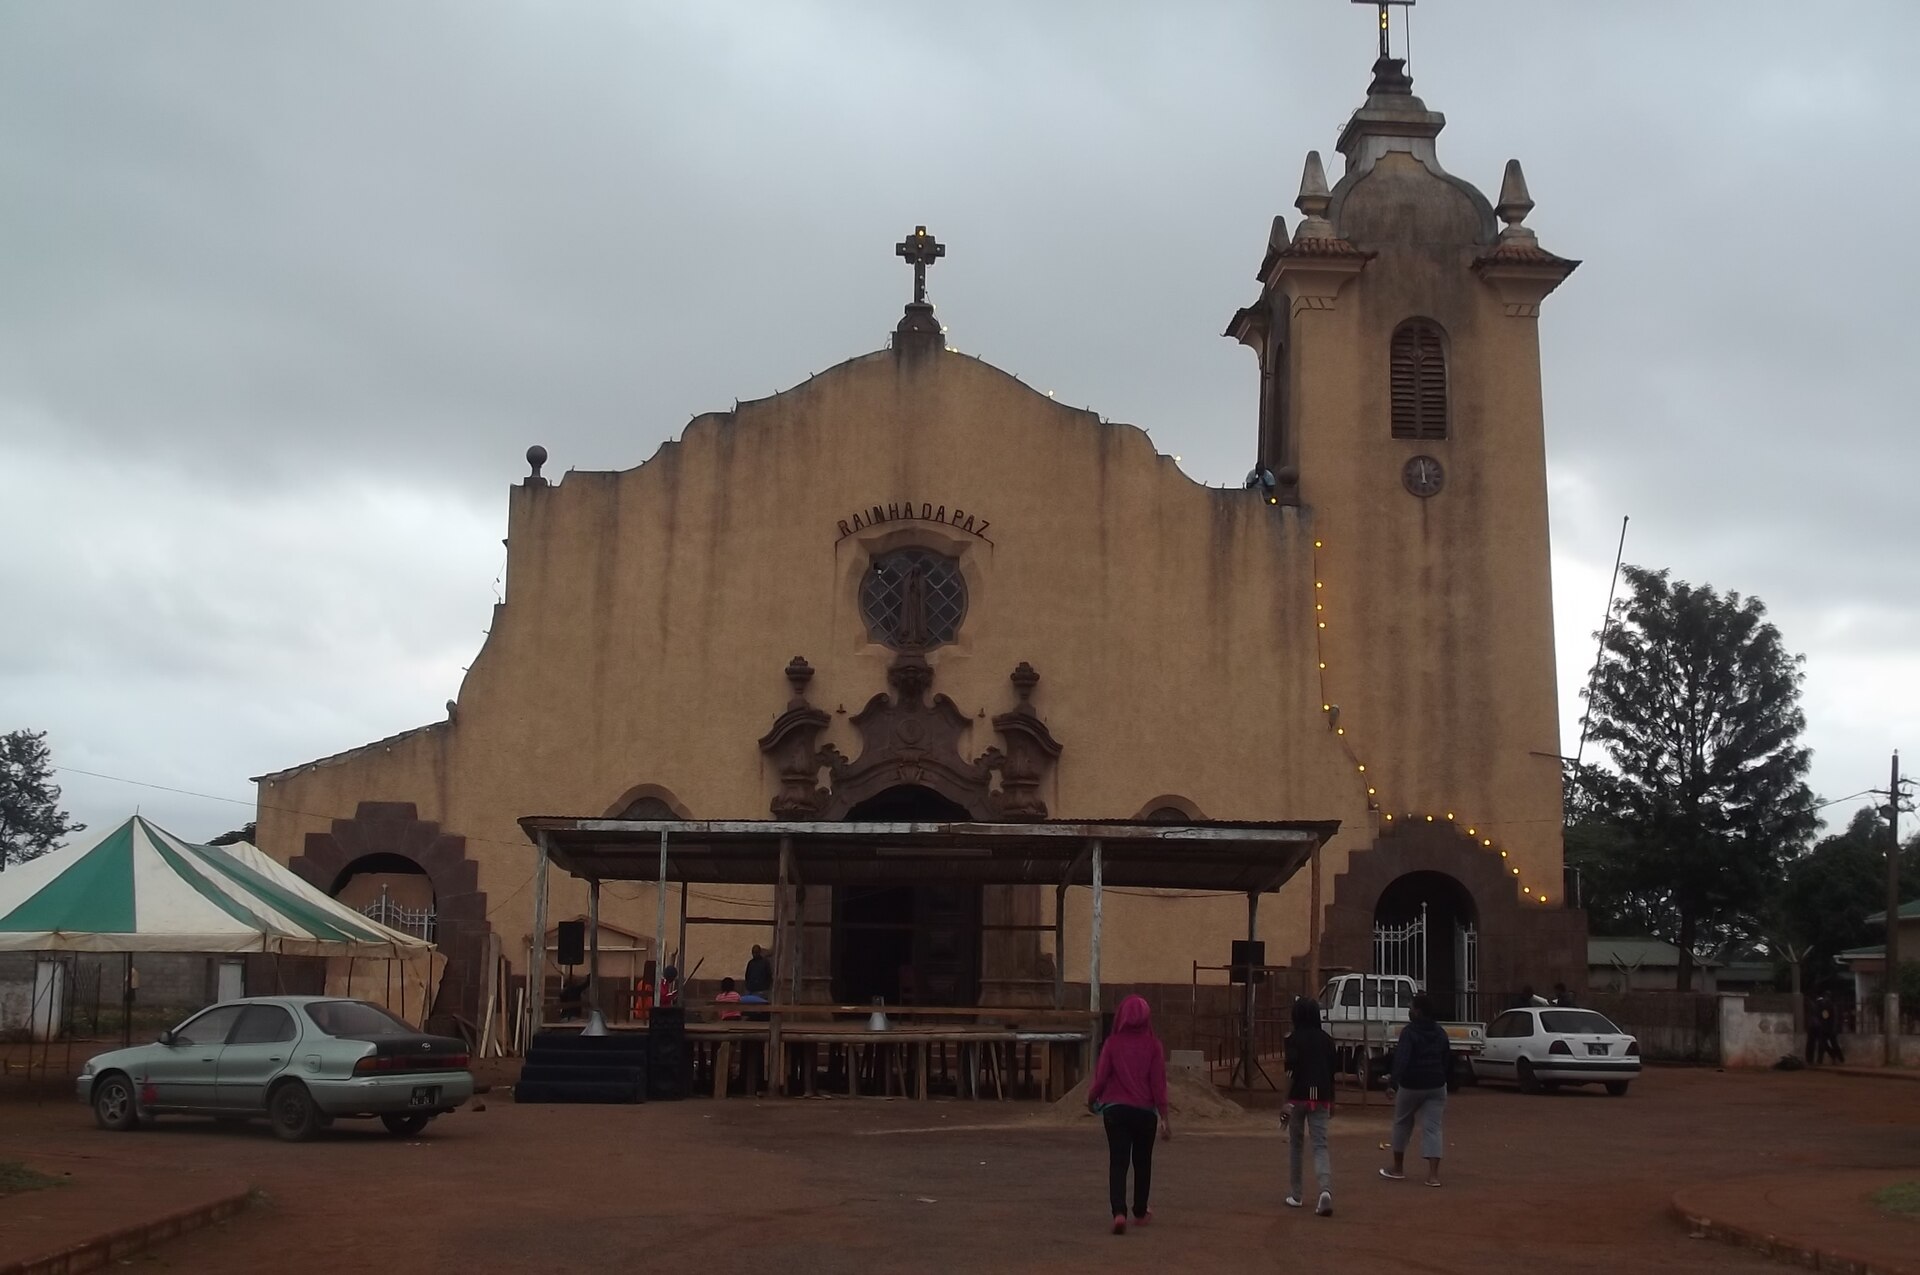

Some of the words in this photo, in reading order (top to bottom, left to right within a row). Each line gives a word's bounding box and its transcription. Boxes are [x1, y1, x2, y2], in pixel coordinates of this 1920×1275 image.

[837, 502, 914, 537] RAINHA
[921, 503, 946, 523] DA
[952, 509, 990, 538] PAZ
